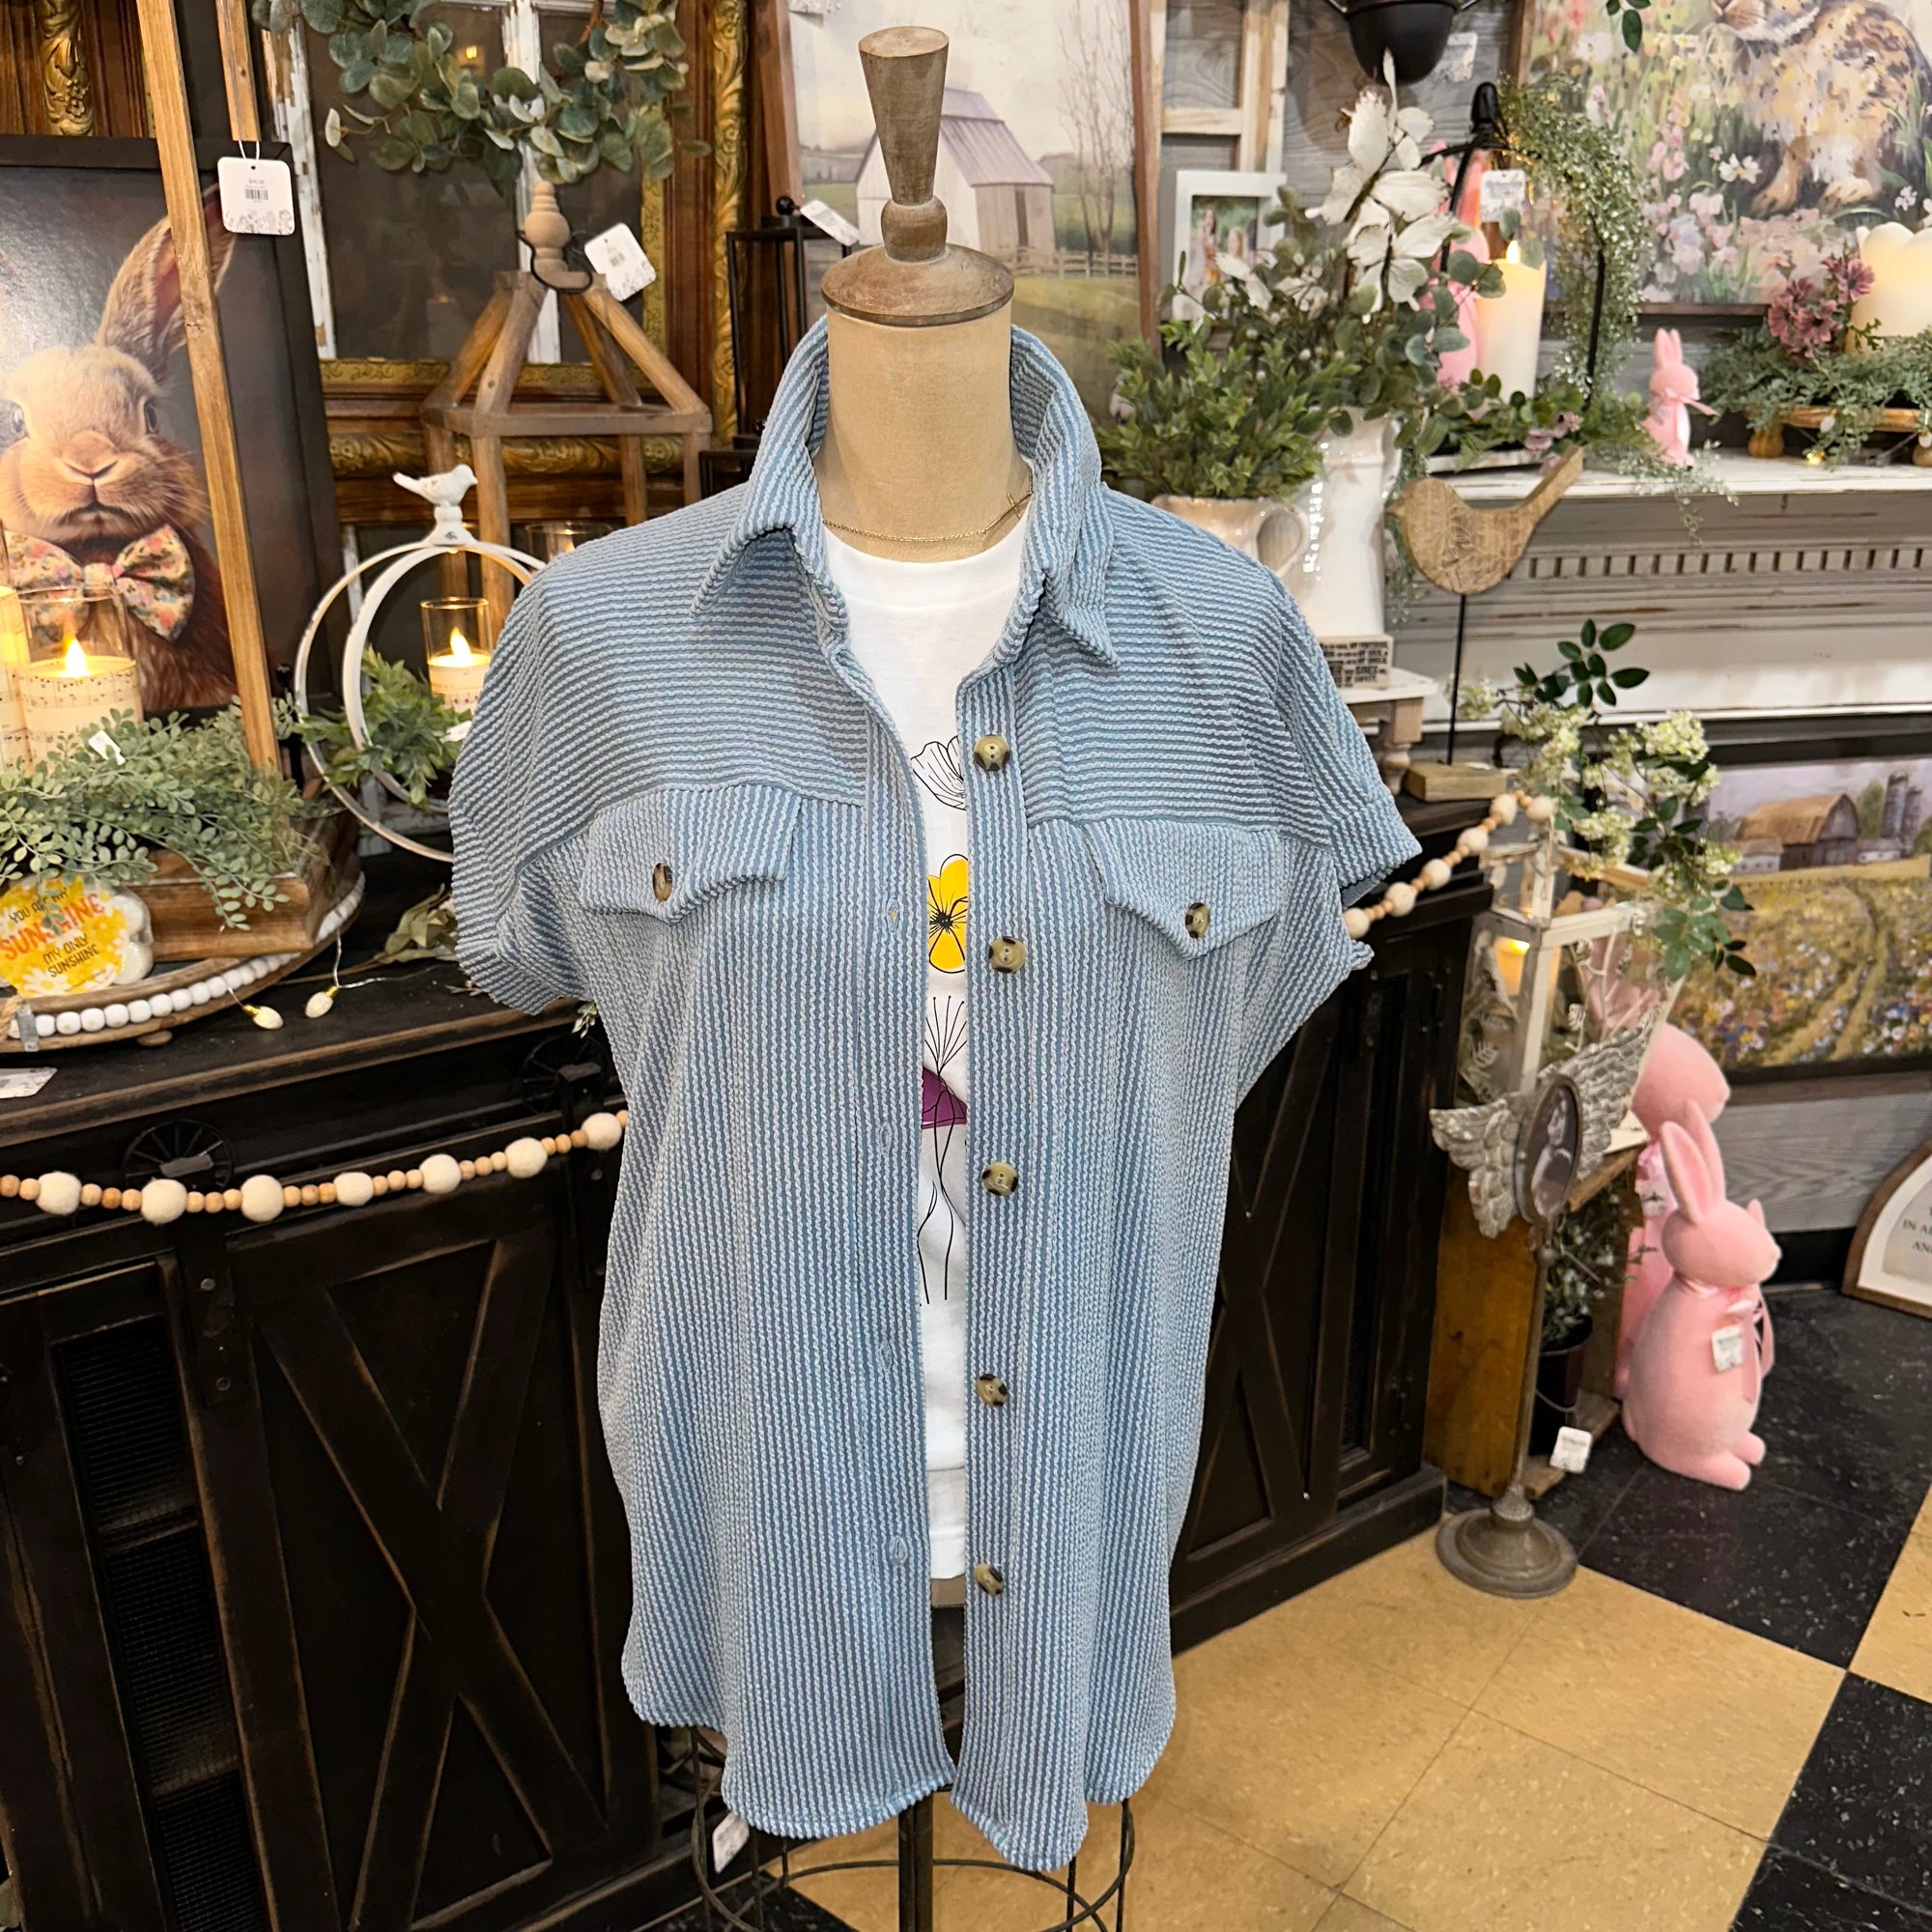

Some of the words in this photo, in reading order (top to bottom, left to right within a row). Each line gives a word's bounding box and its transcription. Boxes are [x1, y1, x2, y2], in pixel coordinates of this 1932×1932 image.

[0, 893, 104, 961] SUNHINE
[9, 906, 30, 923] YOU
[43, 947, 61, 965] MY
[63, 933, 89, 954] ONLY
[48, 944, 100, 978] SUNSHINE
[1903, 1219, 1918, 1231] IN
